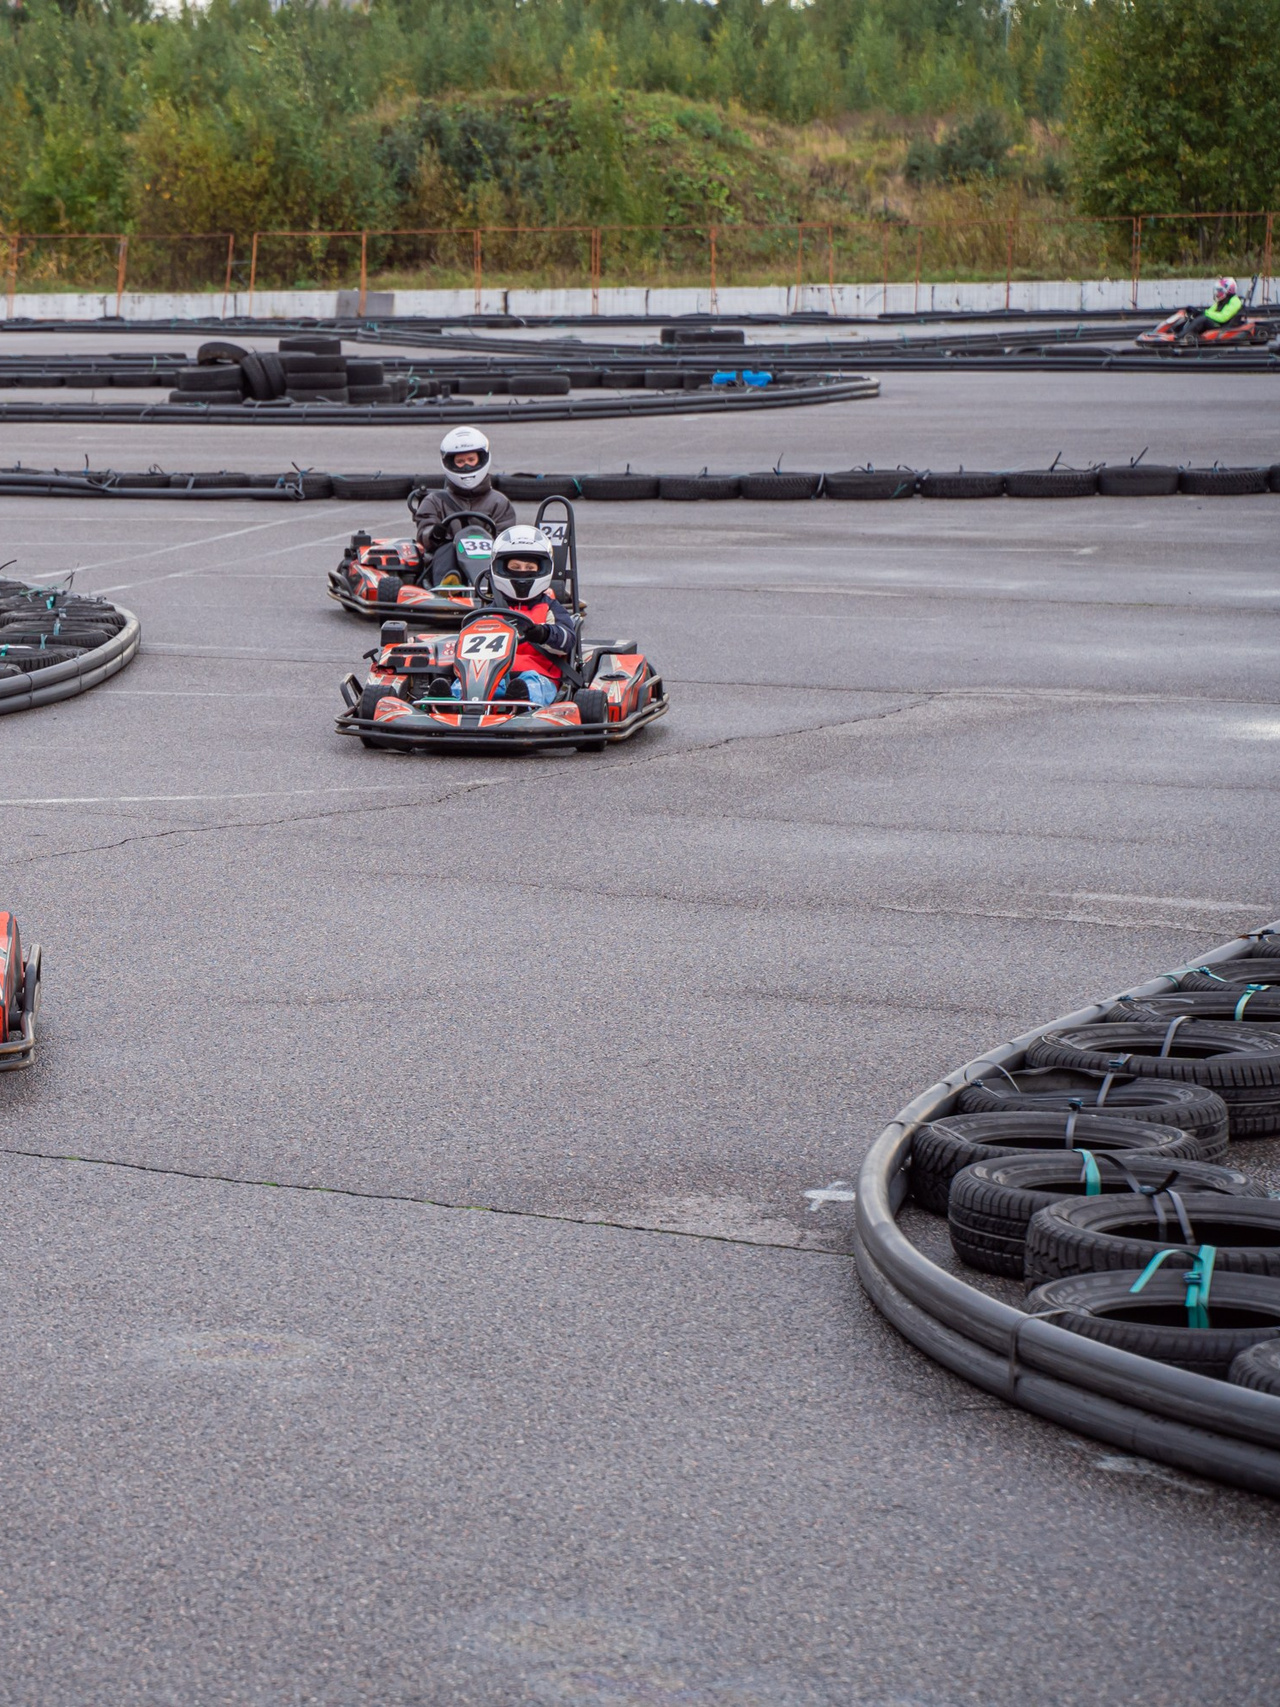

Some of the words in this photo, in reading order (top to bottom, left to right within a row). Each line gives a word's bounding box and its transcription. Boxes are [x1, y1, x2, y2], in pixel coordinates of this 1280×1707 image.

[541, 526, 565, 540] 24
[465, 541, 492, 551] 38
[463, 635, 506, 654] 24
